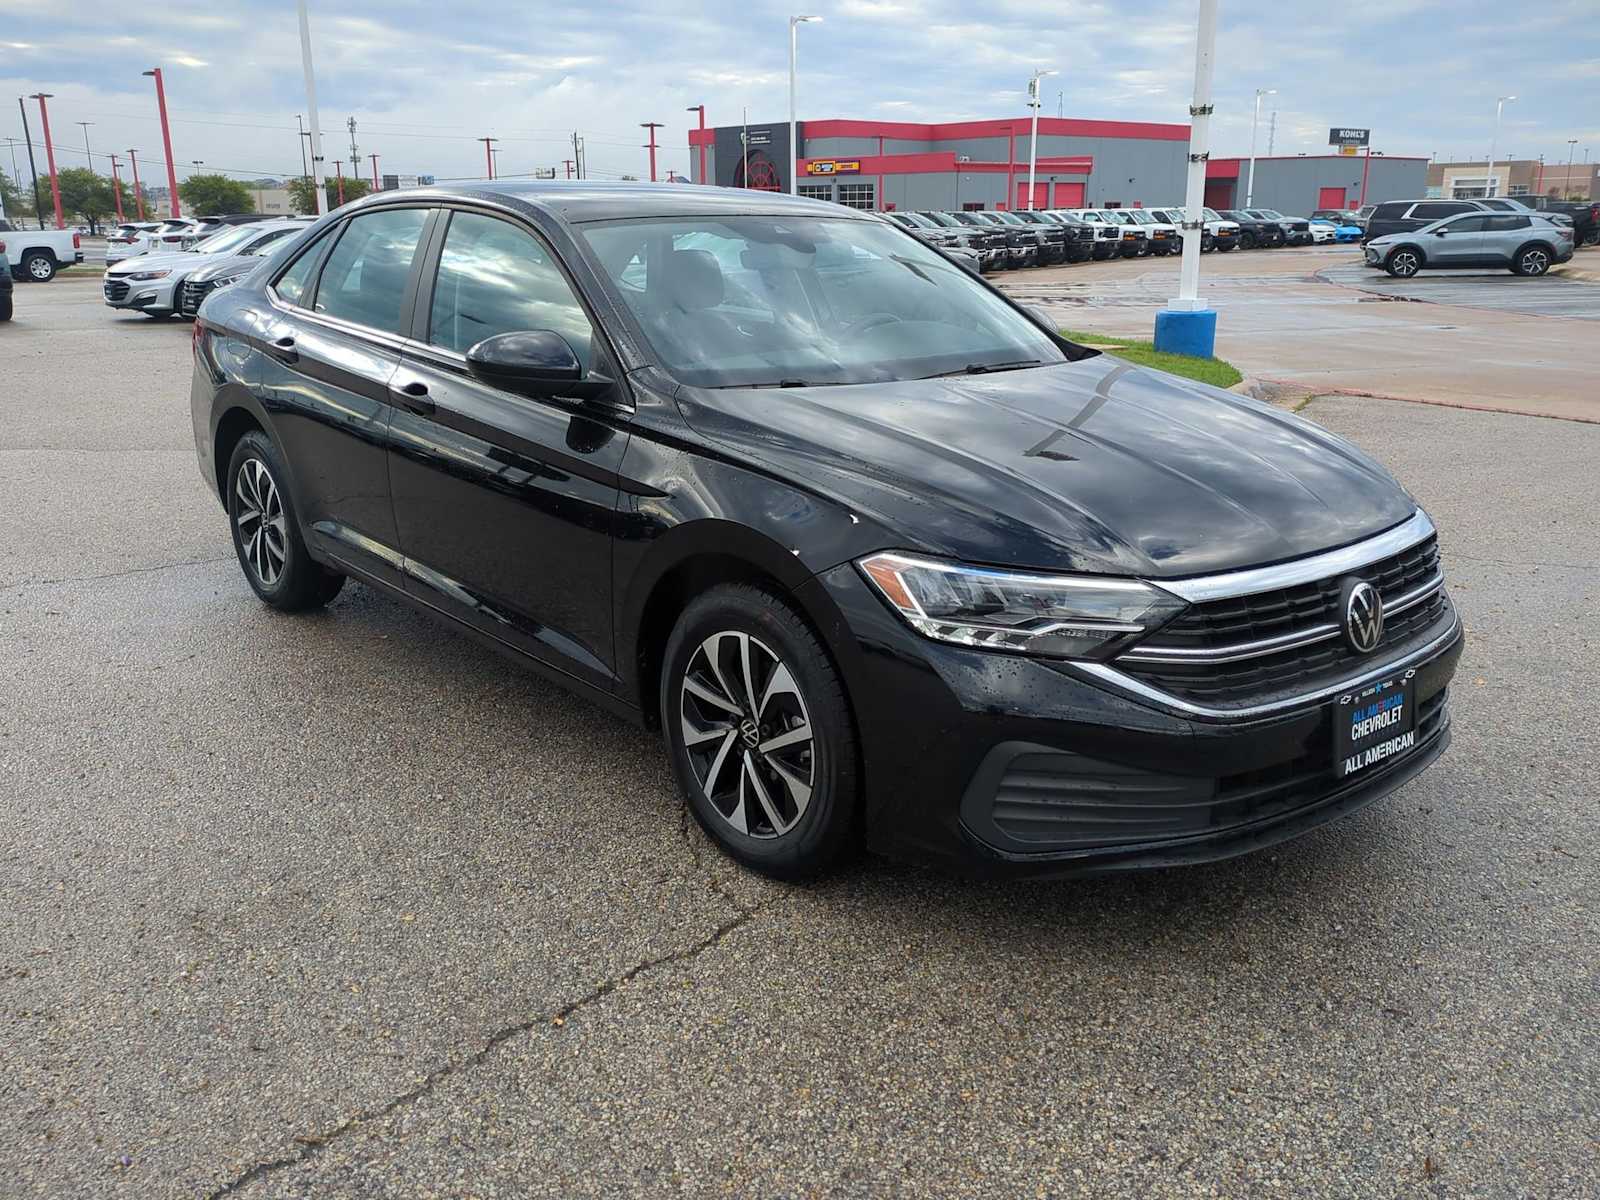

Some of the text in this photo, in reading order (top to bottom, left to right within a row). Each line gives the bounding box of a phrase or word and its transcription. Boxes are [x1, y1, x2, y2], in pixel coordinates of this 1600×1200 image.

[1339, 130, 1365, 138] KOHL'S
[1352, 705, 1403, 741] CHEVROLET
[1353, 709, 1367, 724] ALL
[1345, 731, 1415, 775] ALL AMERICAN
